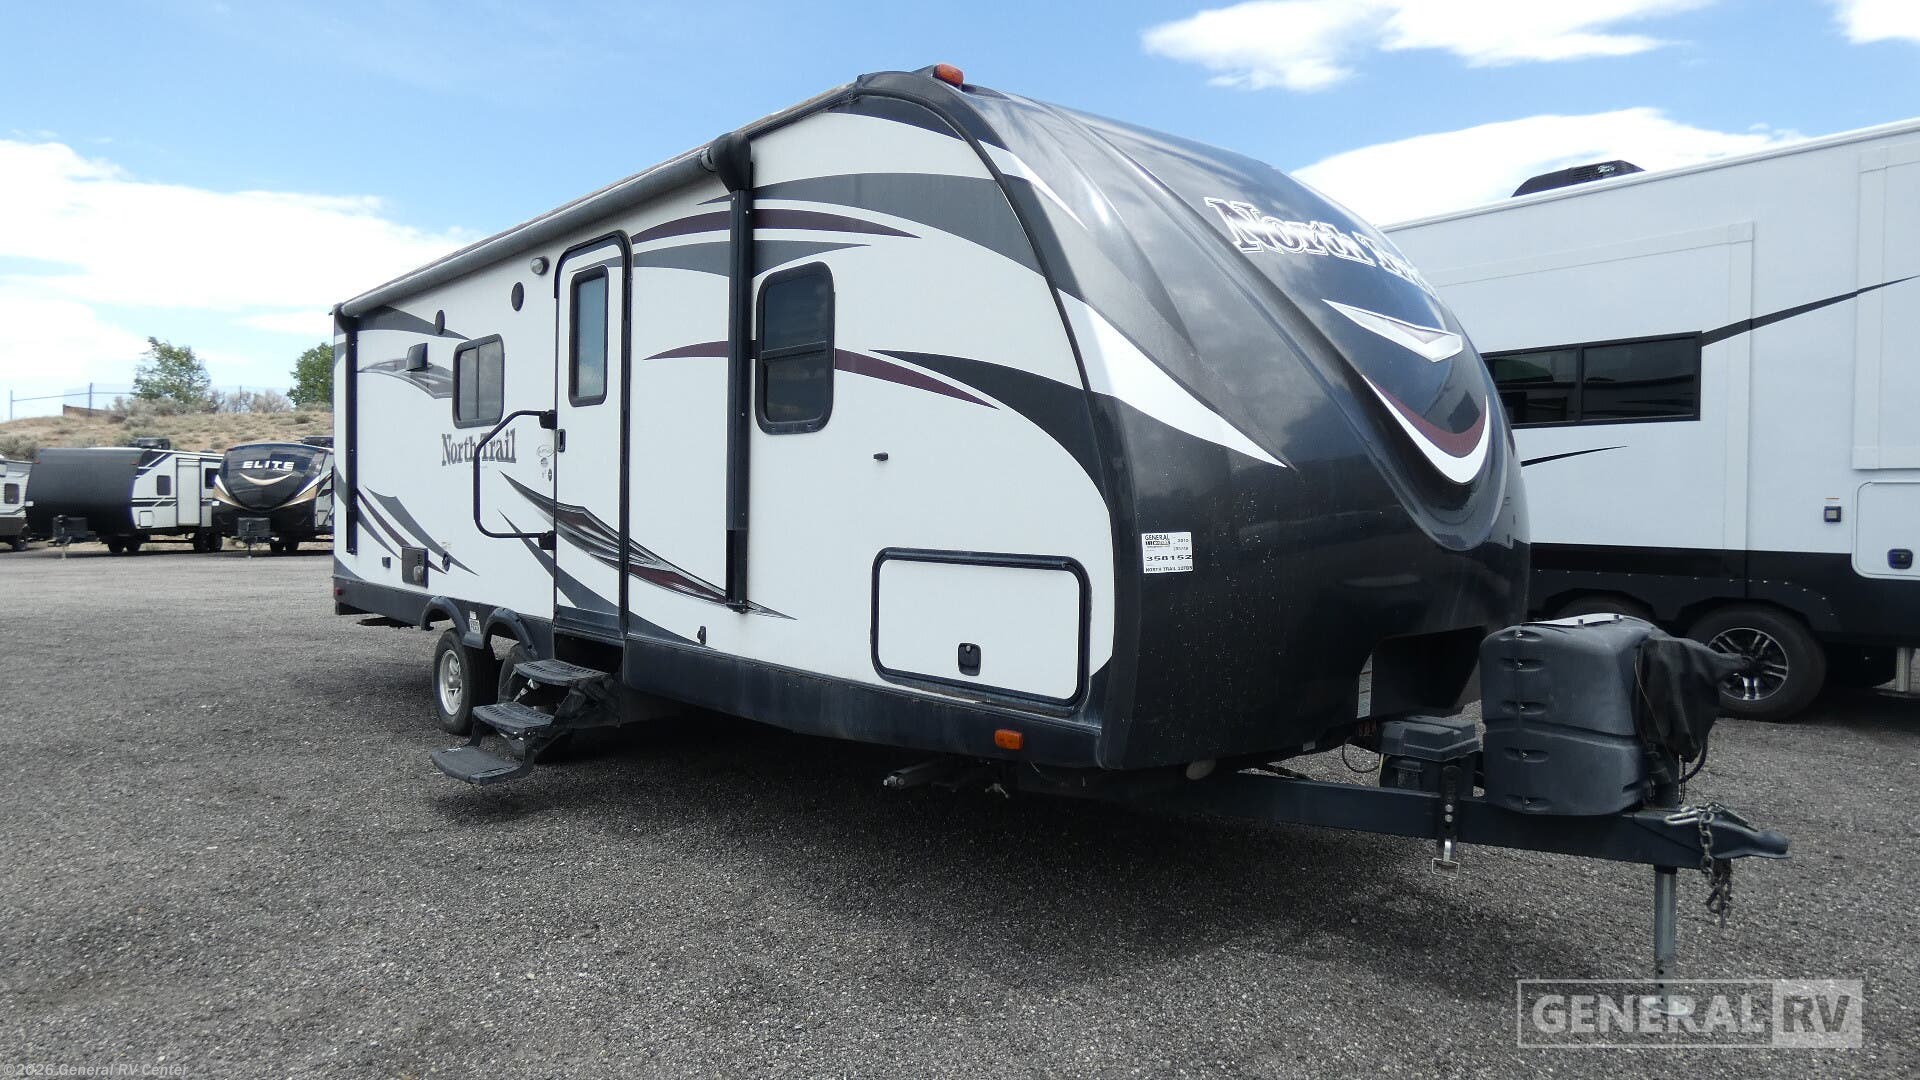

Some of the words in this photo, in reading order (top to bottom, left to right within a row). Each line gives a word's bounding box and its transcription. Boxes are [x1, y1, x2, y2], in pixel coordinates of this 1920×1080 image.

[1204, 197, 1377, 267] North
[242, 460, 295, 471] ELITE
[441, 433, 478, 466] North
[479, 428, 517, 464] Trail
